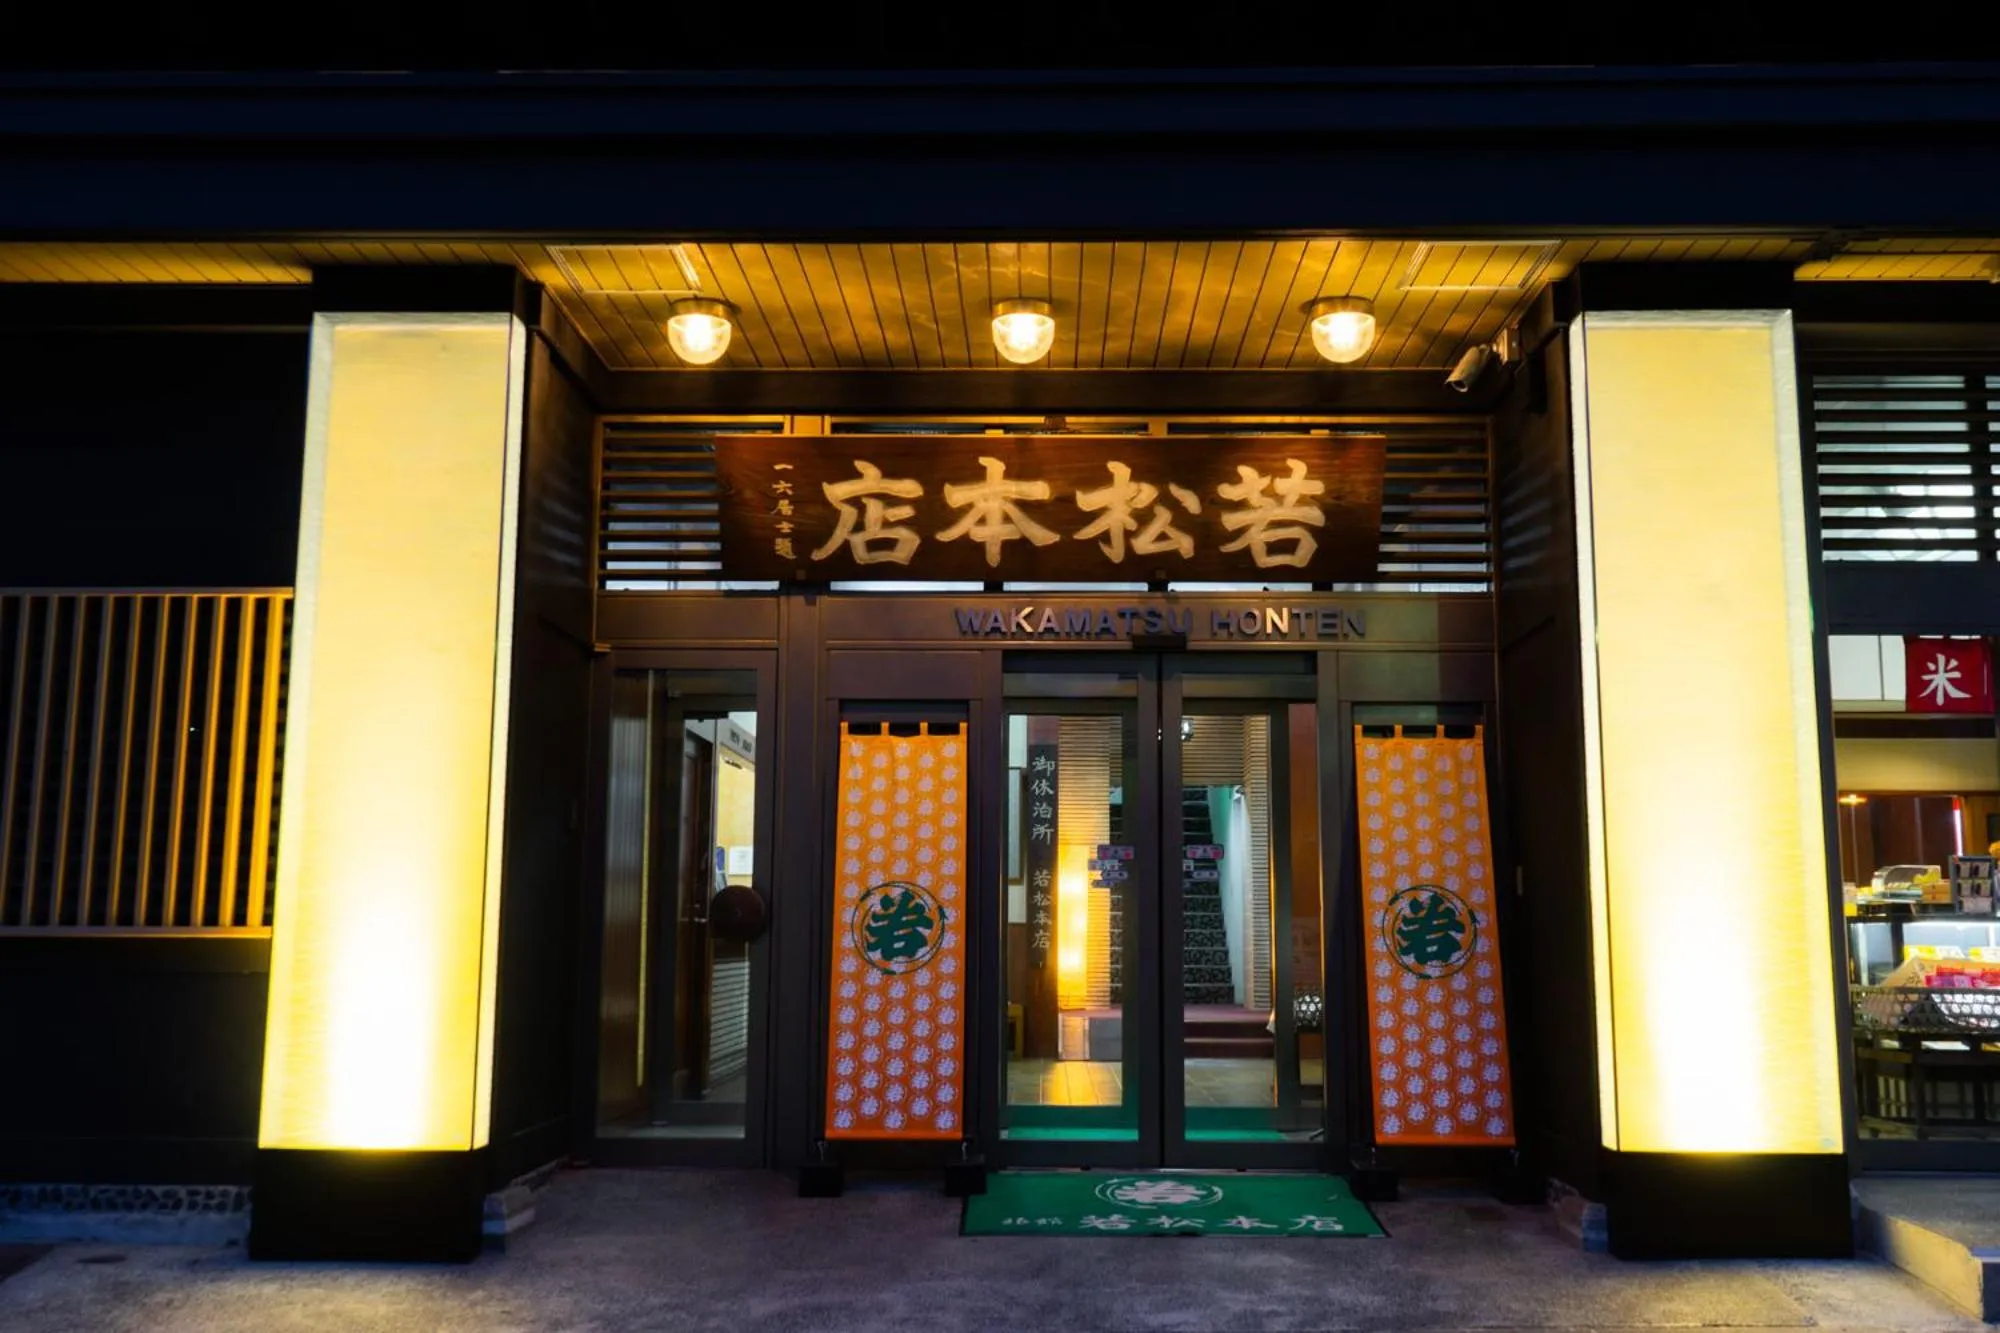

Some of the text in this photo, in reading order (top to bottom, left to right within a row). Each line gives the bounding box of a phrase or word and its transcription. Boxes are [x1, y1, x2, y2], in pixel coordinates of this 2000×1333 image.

[809, 457, 1326, 569] 若松本店
[953, 606, 1367, 638] WAKAMATSU HONTEN
[1918, 652, 1973, 707] 米
[866, 890, 935, 961] 若
[1031, 869, 1053, 949] 若松本店
[1397, 891, 1465, 964] 若
[1078, 1213, 1344, 1231] 若松本店
